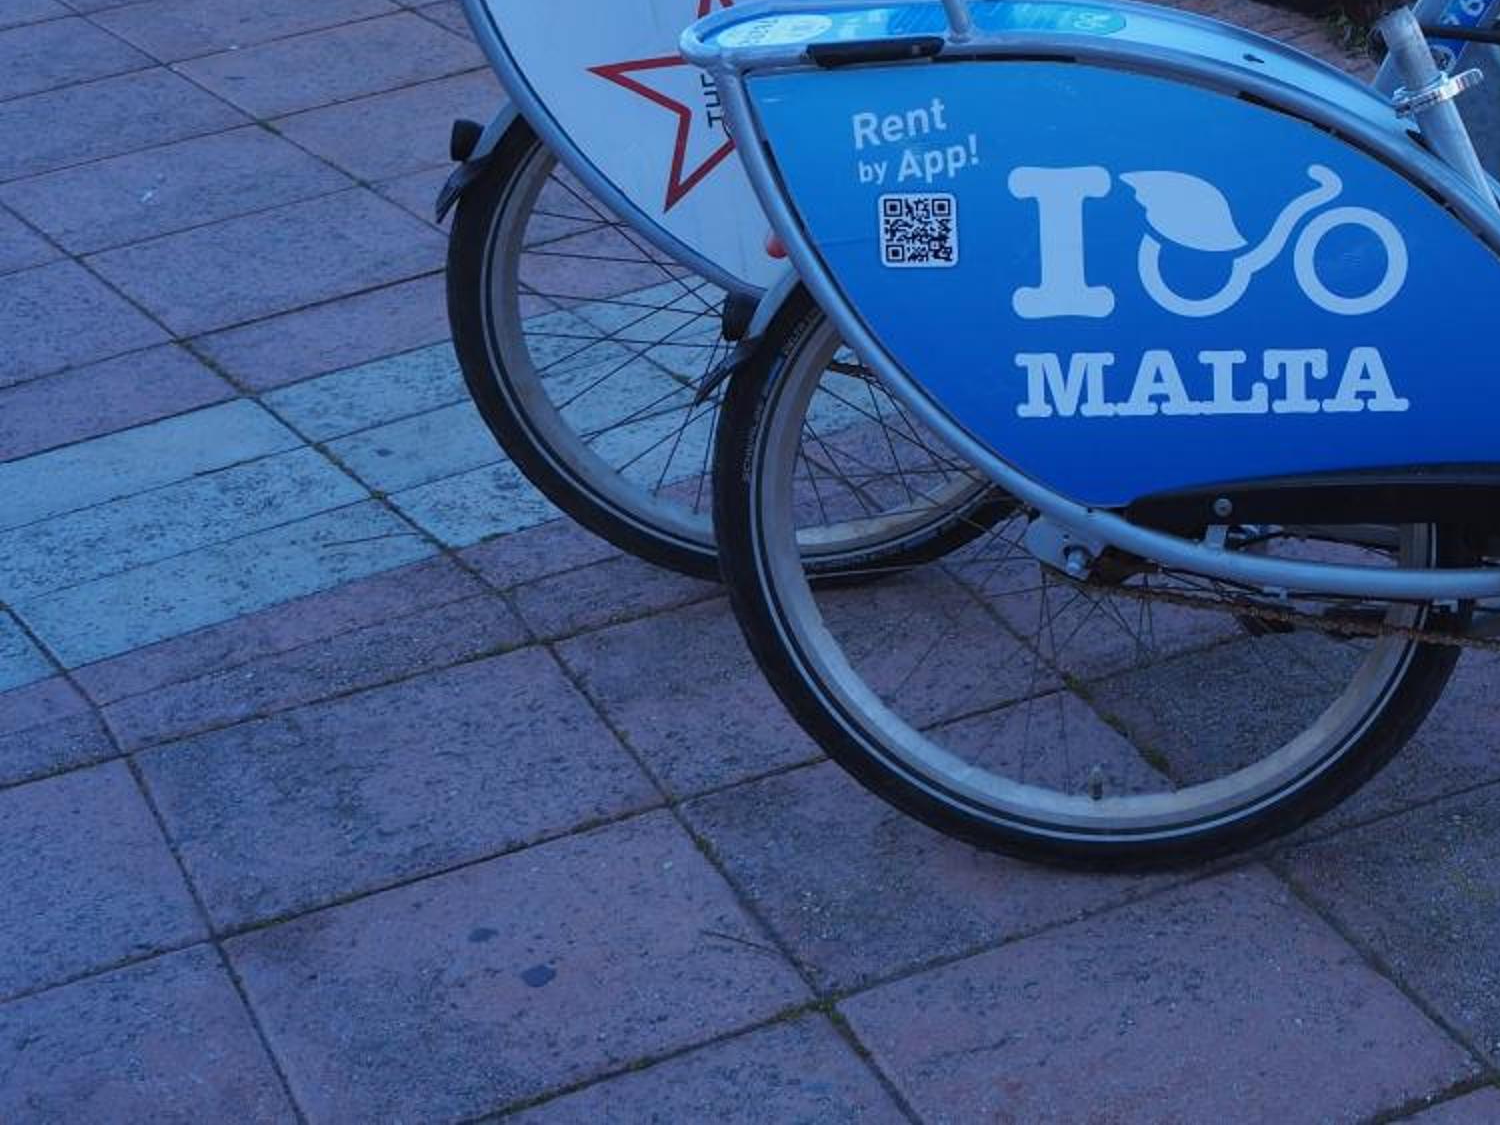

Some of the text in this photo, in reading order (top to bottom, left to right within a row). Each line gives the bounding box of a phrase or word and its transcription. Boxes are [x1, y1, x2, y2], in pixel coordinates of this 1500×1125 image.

[853, 98, 947, 149] Rent
[857, 134, 980, 184] by App!
[1007, 165, 1116, 318] I
[1014, 346, 1410, 418] MALTA
